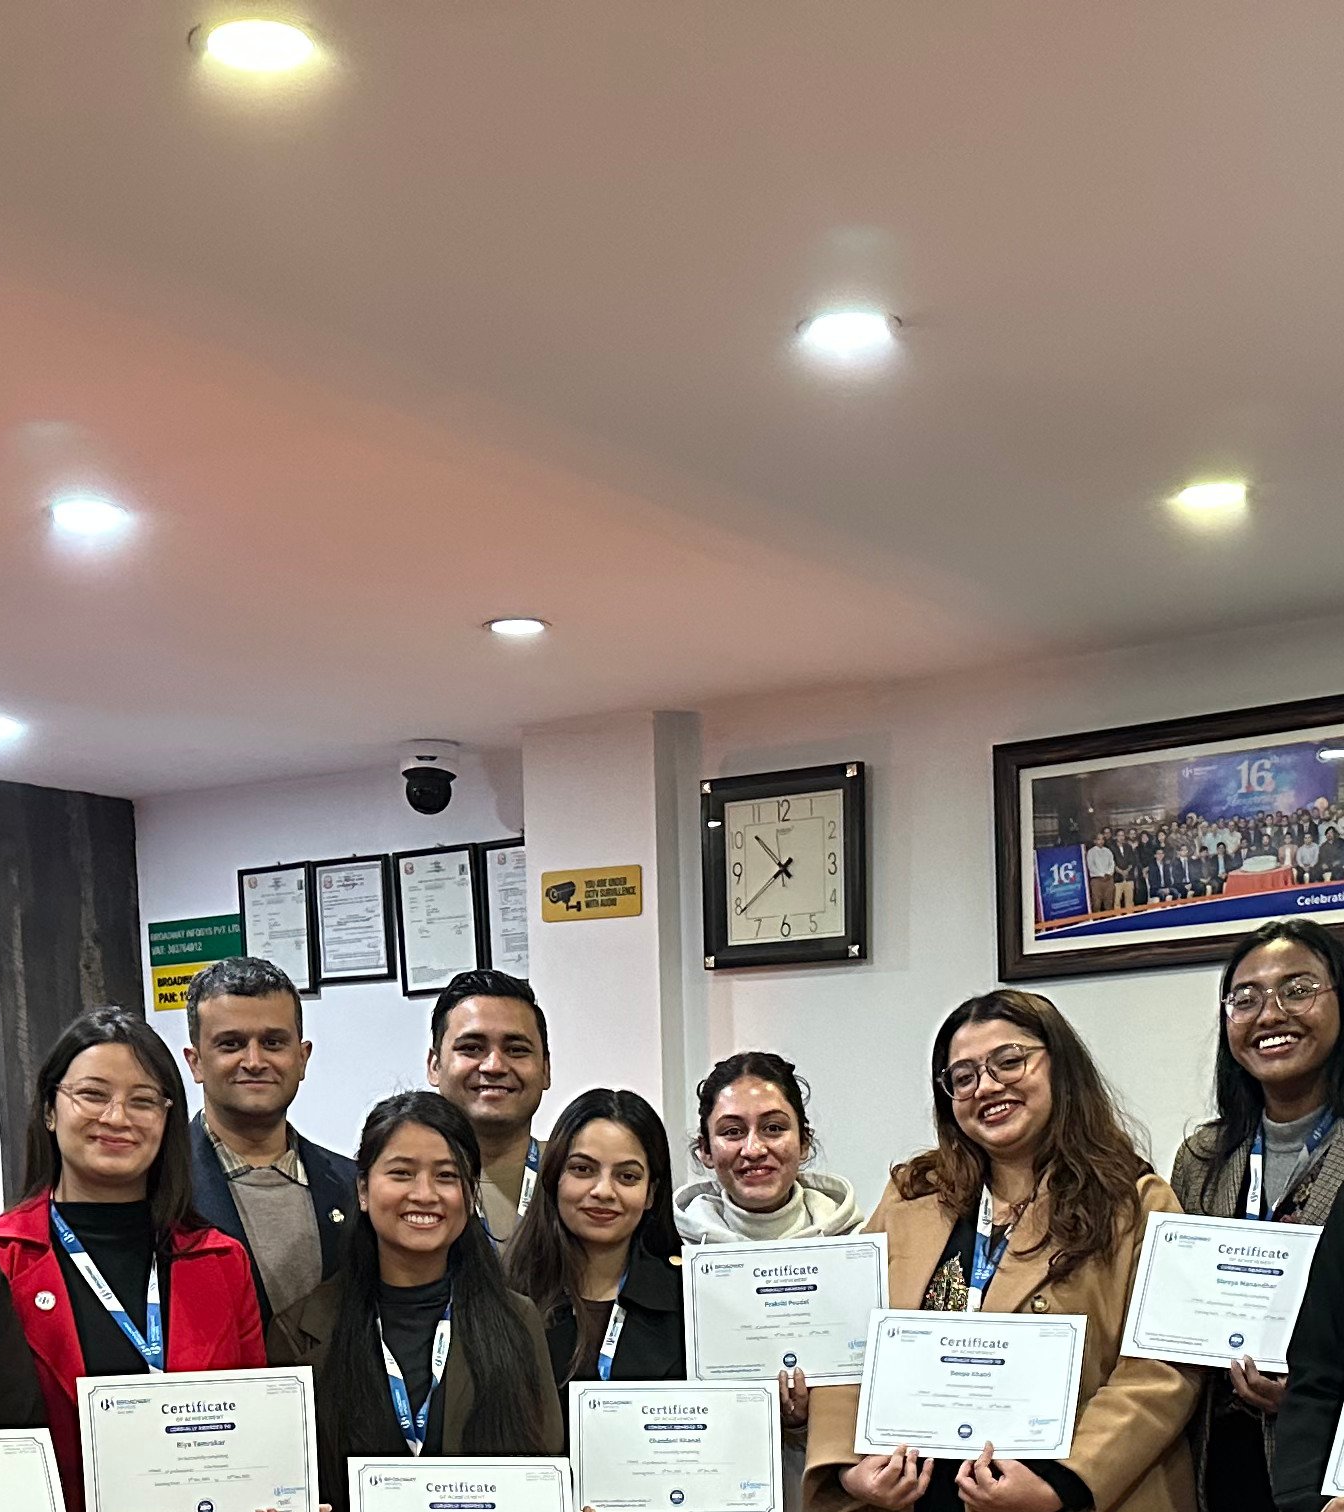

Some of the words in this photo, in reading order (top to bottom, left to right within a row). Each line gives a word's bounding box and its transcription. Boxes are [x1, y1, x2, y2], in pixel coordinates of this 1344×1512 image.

[776, 799, 791, 823] 12
[827, 820, 837, 840] 2
[732, 862, 743, 885] 9
[827, 852, 837, 875] 3
[734, 897, 743, 915] 8
[829, 888, 837, 906] 4
[780, 914, 791, 937] 6
[809, 913, 818, 933] 5
[1218, 1244, 1289, 1259] Certificate
[753, 1265, 818, 1277] Certificate
[940, 1337, 1009, 1349] Certificate
[161, 1401, 236, 1414] Certificate
[641, 1405, 709, 1414] Certificate
[426, 1482, 496, 1492] Certificate
